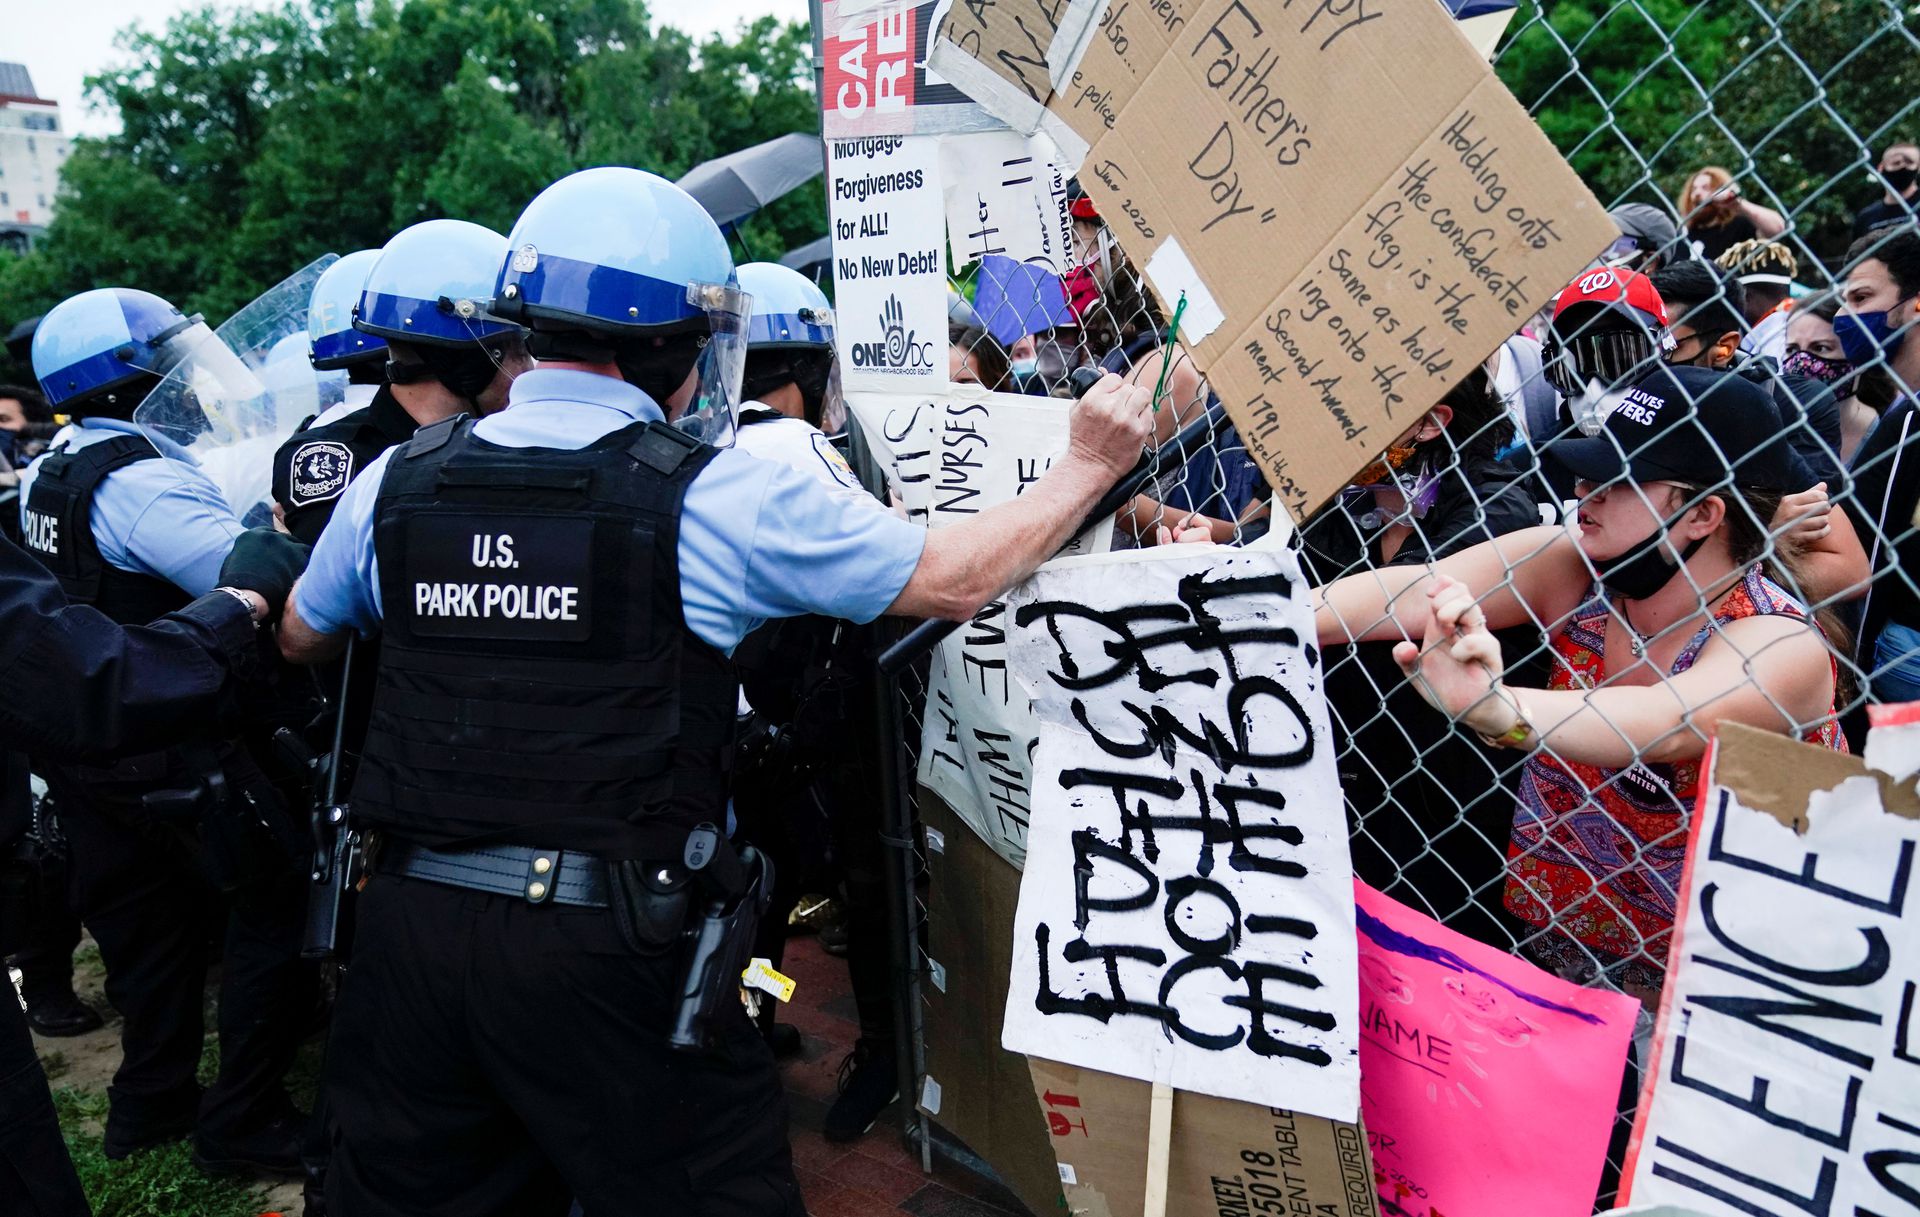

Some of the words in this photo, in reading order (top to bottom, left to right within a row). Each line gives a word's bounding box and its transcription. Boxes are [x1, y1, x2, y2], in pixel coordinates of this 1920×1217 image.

[1190, 0, 1311, 165] Father's
[1074, 84, 1115, 130] police
[835, 168, 924, 201] Forgiveness
[1398, 159, 1438, 212] the
[1440, 110, 1507, 213] Holding
[1506, 207, 1562, 249] onto
[836, 217, 857, 241] for
[859, 212, 889, 237] ALL!
[1121, 199, 1155, 239] 2020
[838, 258, 860, 280] No
[861, 256, 894, 279] New
[898, 249, 938, 275] Debt!
[1327, 248, 1373, 307] Same
[1372, 306, 1401, 334] as
[1408, 258, 1432, 290] is
[1434, 282, 1476, 335] the
[852, 342, 887, 367] ONE
[910, 341, 934, 367] DC
[1244, 339, 1287, 385] ment
[1327, 315, 1370, 363] onto
[1371, 364, 1407, 420] the
[1616, 400, 1657, 426] TERS
[1632, 389, 1665, 410] LIVES
[934, 403, 990, 514] NURSES
[25, 509, 58, 555] POLICE
[472, 534, 519, 569] U.S.
[415, 582, 480, 618] PARK
[483, 584, 579, 621] POLICE
